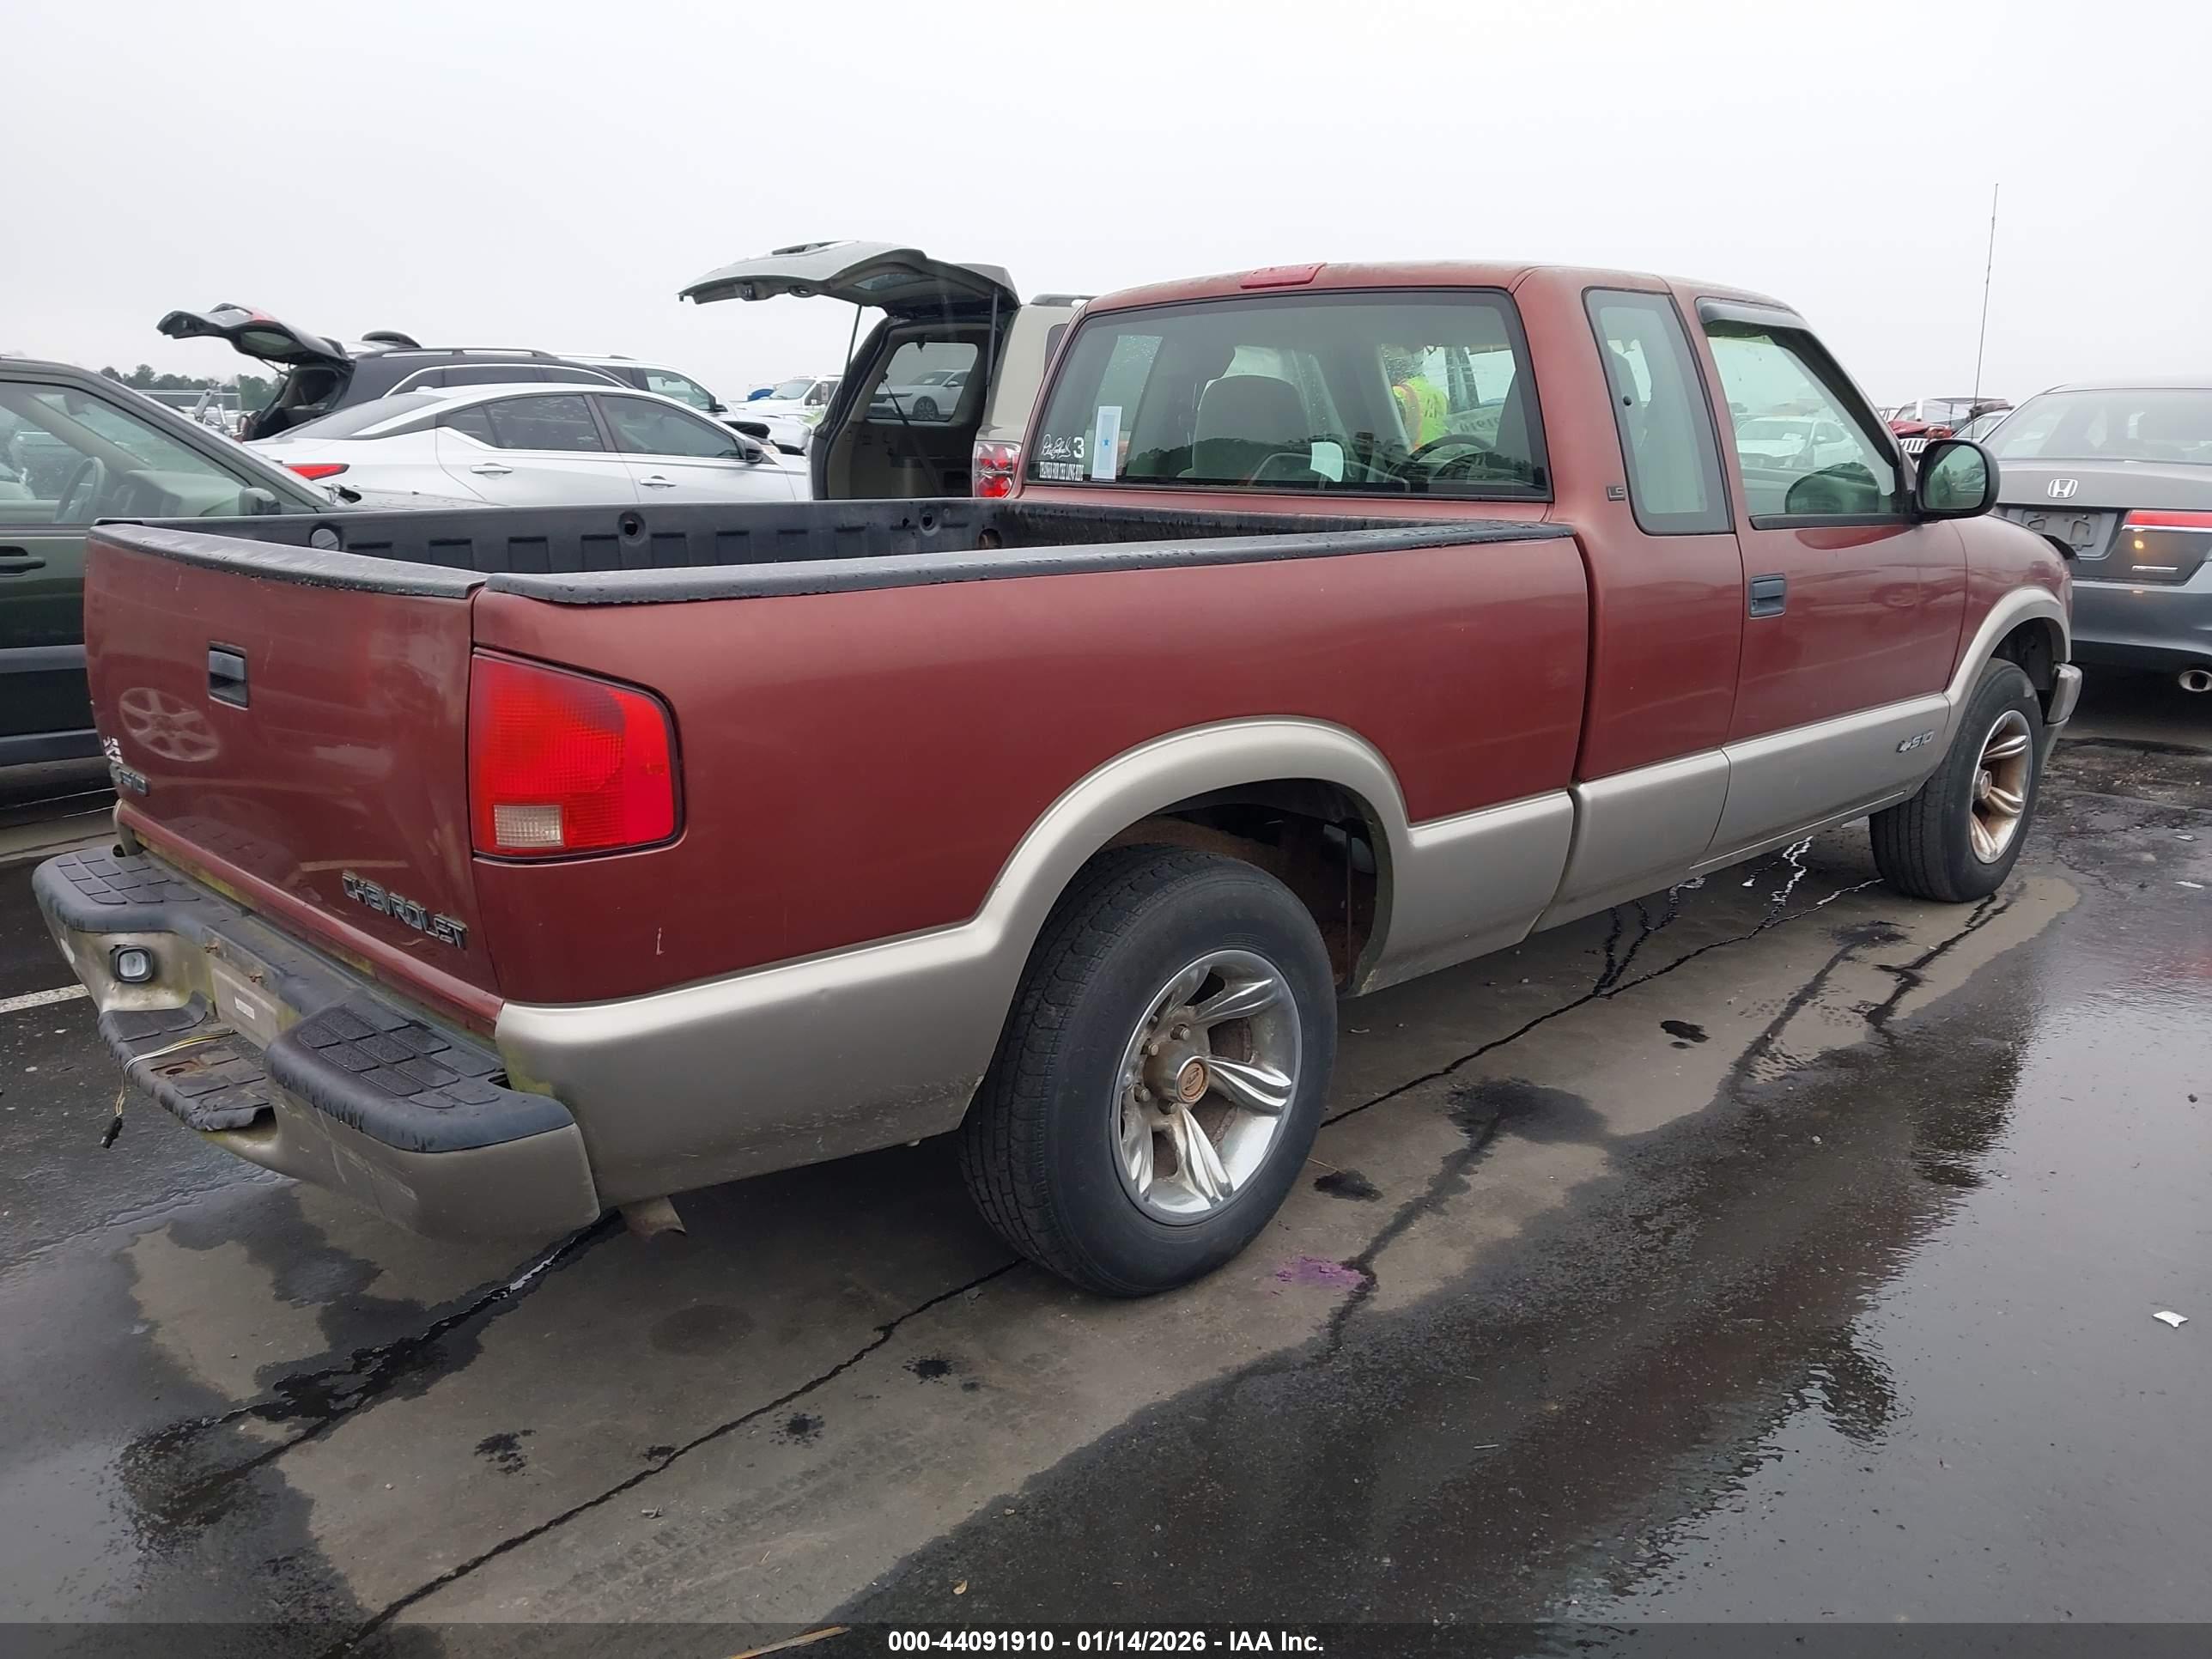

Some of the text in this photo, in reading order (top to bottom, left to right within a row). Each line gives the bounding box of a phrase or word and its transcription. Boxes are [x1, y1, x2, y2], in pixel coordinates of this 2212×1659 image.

[1073, 436, 1085, 459] 3
[1607, 486, 1625, 500] LS
[342, 870, 468, 951] CHEVROLET
